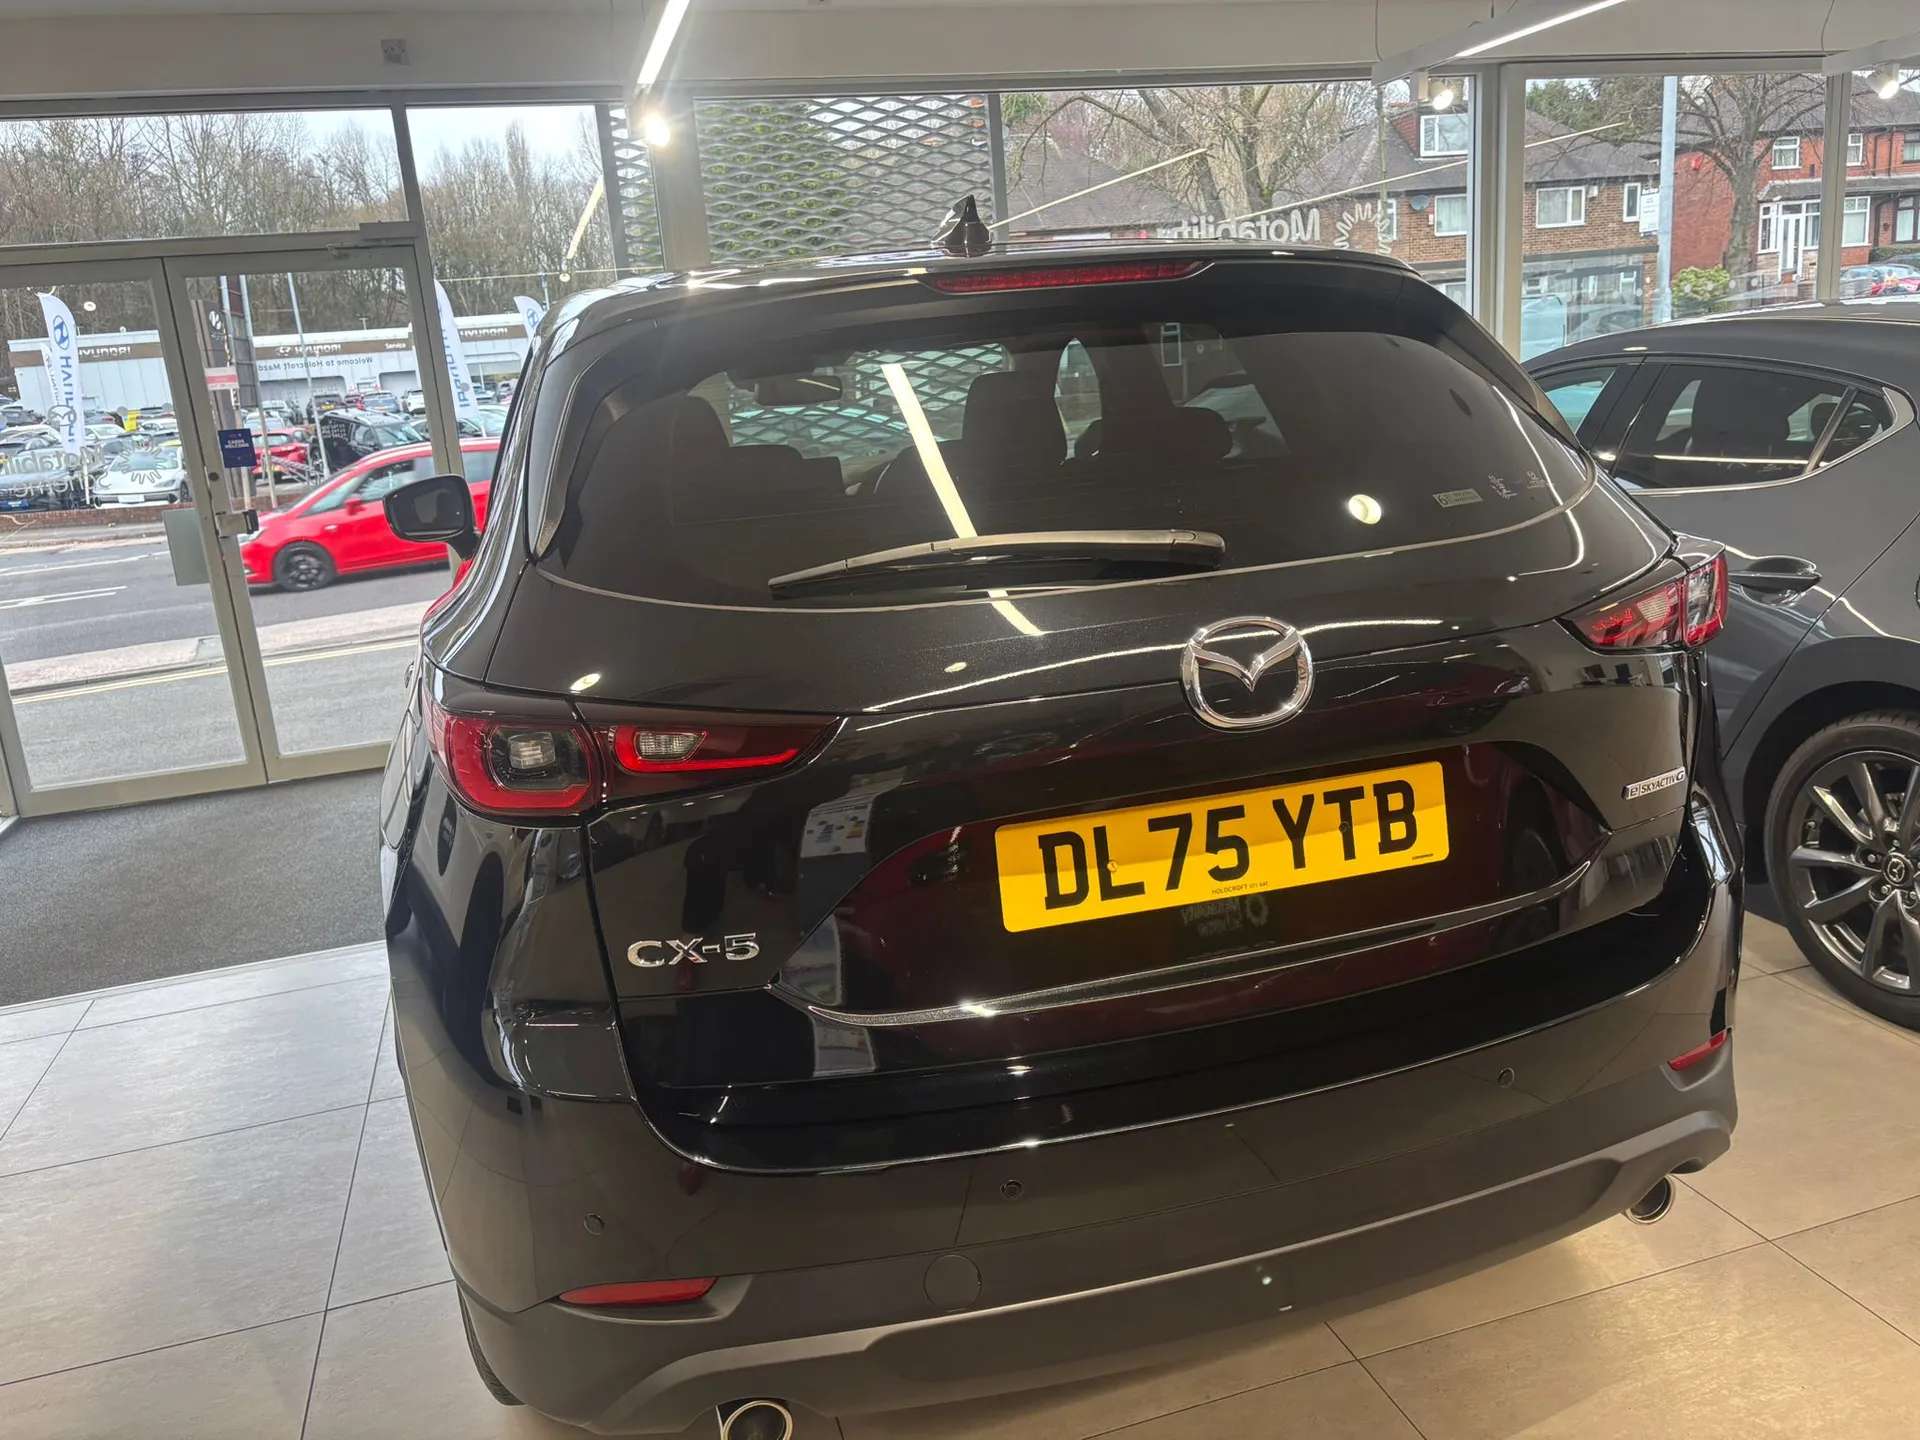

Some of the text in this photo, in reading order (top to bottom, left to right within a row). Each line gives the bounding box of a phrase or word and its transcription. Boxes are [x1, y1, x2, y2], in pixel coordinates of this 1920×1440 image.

[1038, 779, 1417, 910] DL75 YTB
[627, 932, 760, 967] CX-5
